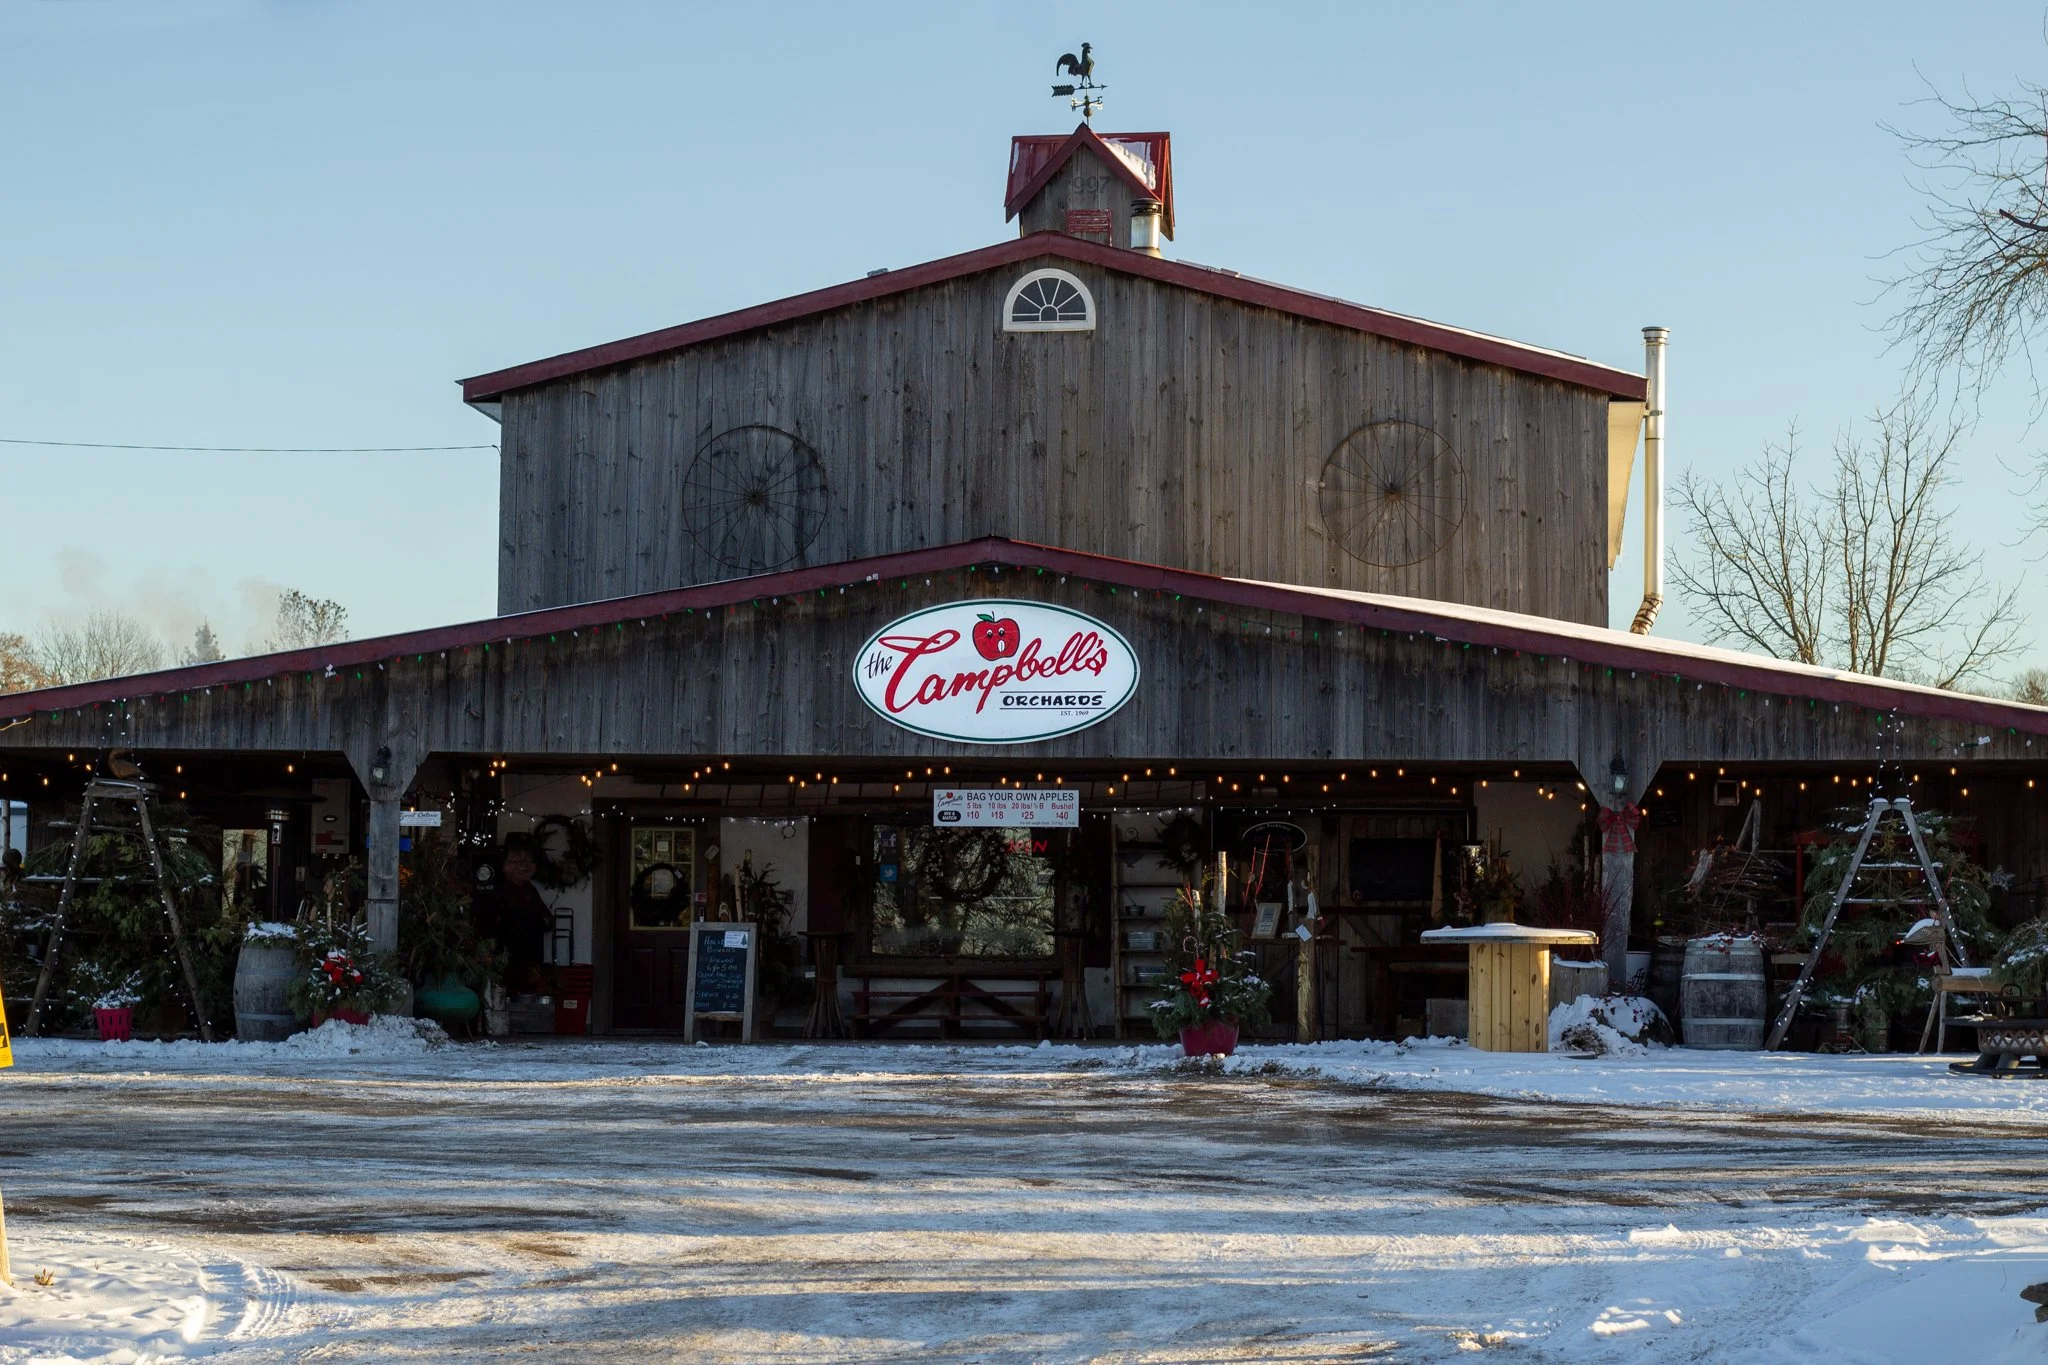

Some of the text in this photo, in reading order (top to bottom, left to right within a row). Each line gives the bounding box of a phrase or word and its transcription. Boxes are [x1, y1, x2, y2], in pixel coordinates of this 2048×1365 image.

[864, 630, 1108, 714] the Campbell's
[1002, 695, 1102, 706] ORCHARDS
[966, 792, 1074, 801] BAG YOUR OWN APPLES
[966, 811, 1069, 820] $10 $18 $25 $40
